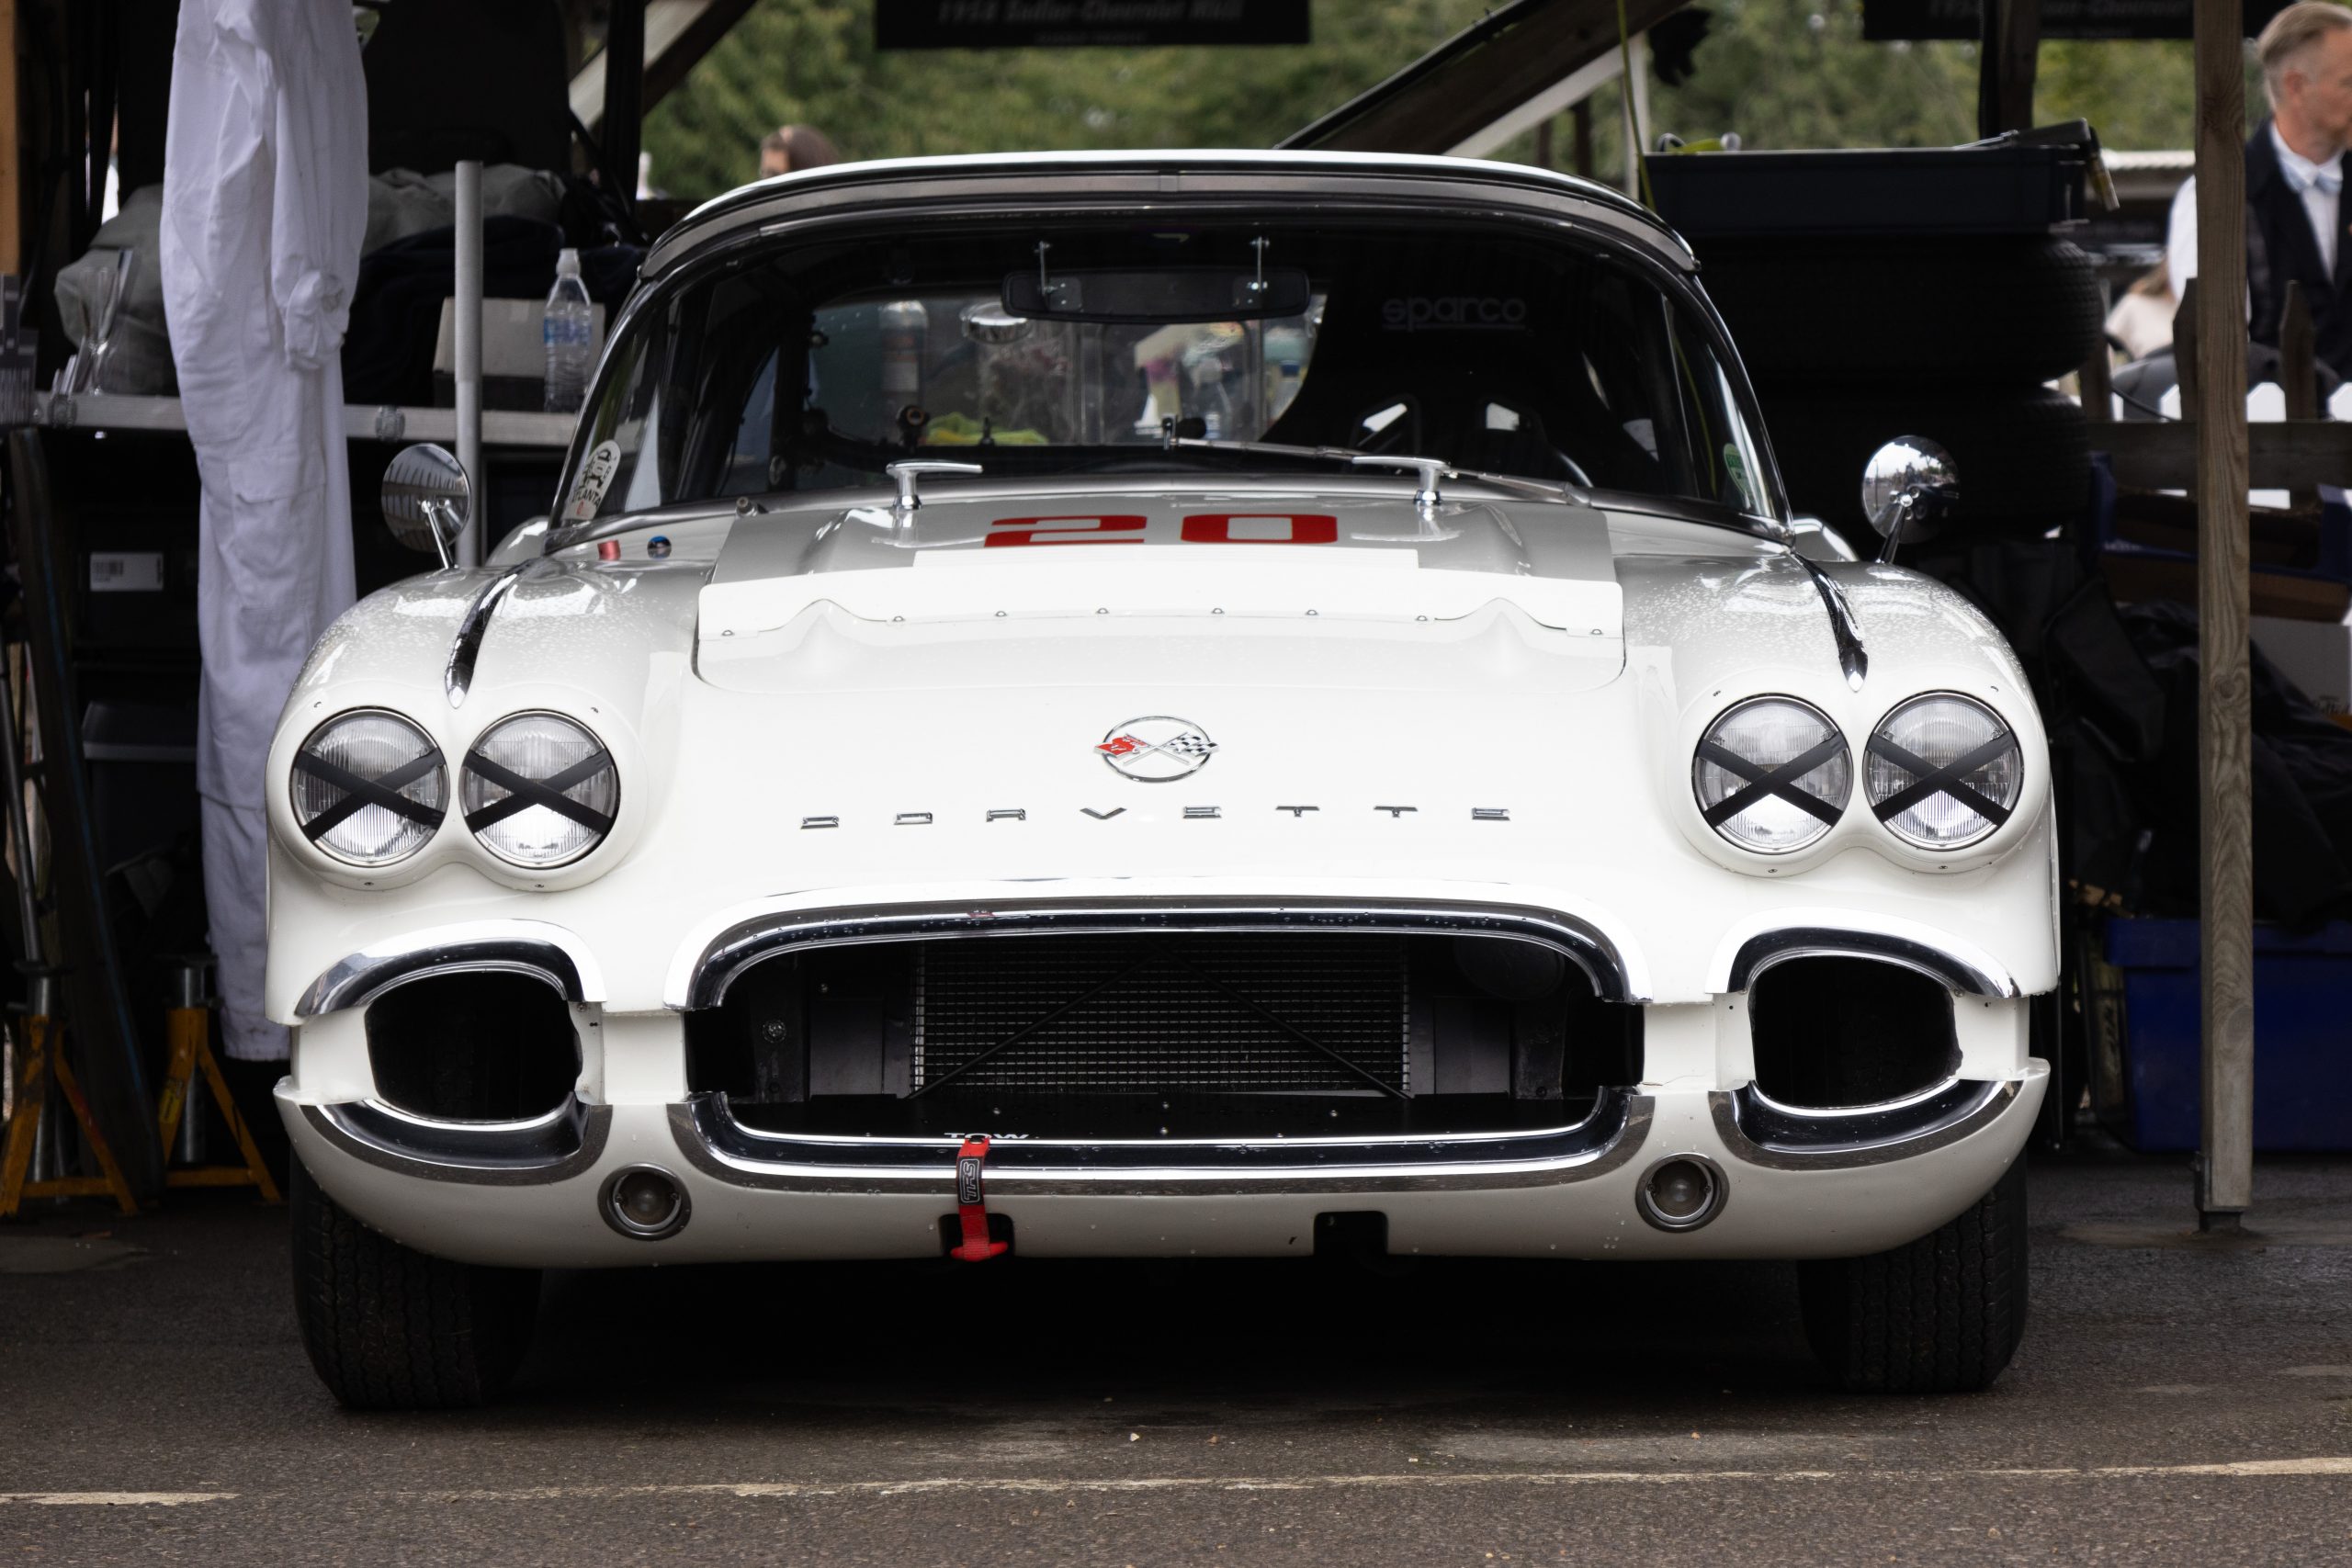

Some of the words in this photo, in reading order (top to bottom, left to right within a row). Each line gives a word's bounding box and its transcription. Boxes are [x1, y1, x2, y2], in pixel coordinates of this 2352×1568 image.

[1382, 297, 1527, 333] sparco
[984, 514, 1339, 548] 20
[800, 806, 1510, 829] CORVETTE
[961, 1161, 978, 1201] TRS
